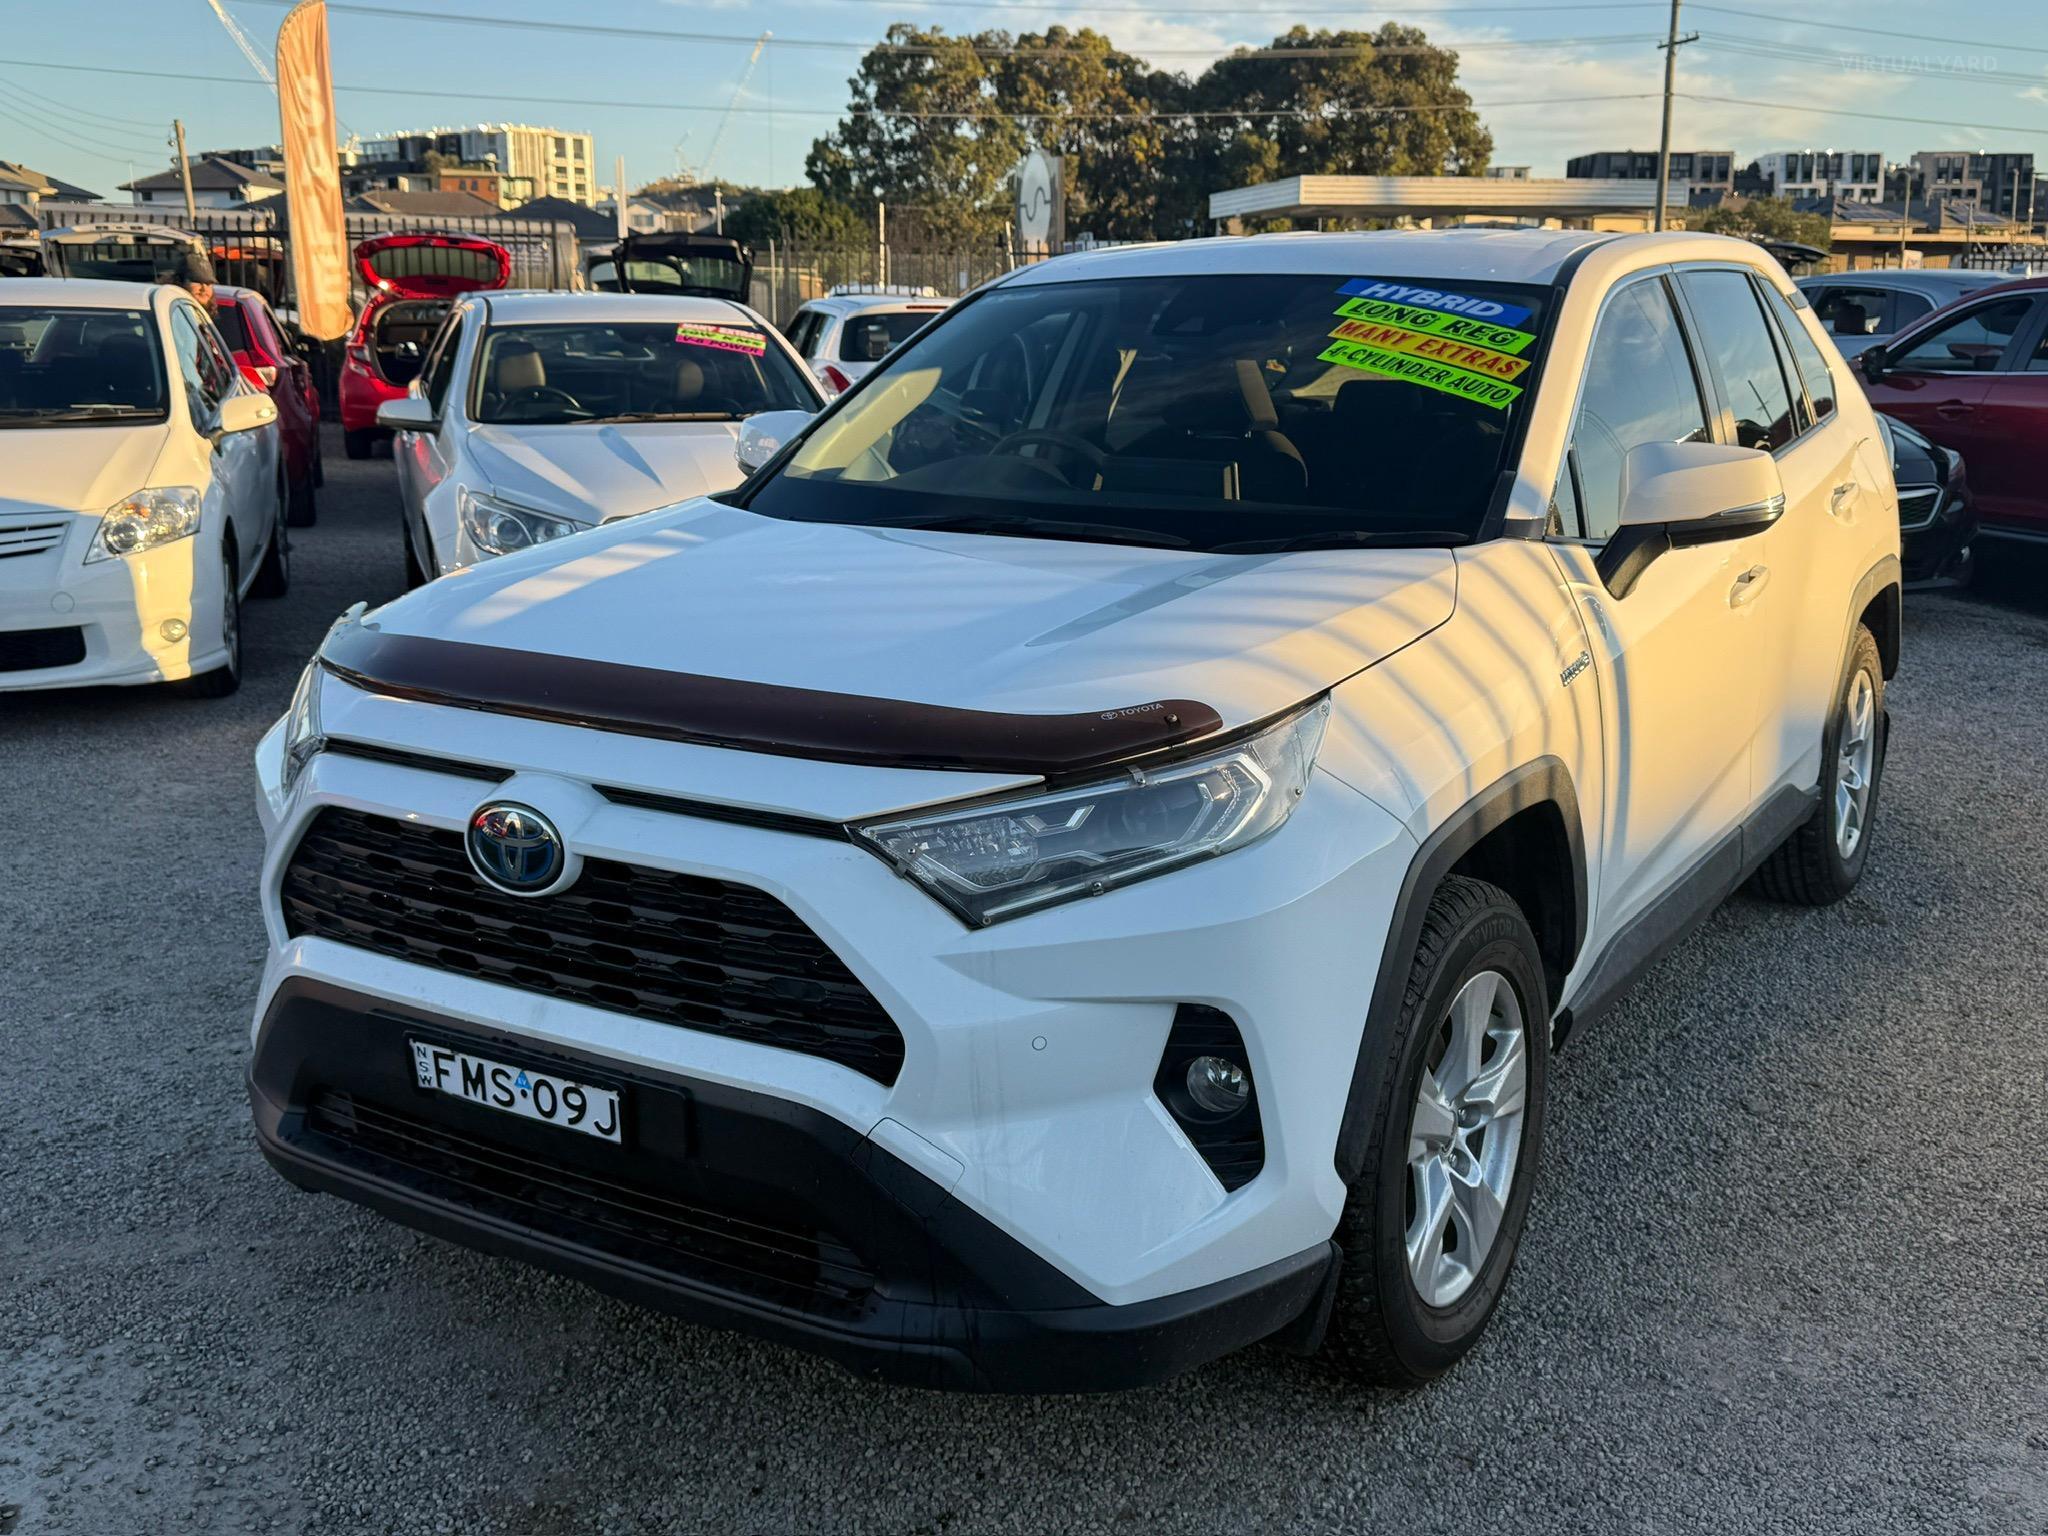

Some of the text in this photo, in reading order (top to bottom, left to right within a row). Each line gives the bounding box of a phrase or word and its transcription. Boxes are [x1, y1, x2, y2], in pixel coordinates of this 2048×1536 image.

[1359, 283, 1504, 317] HYBRID
[1348, 301, 1520, 346] LONG REG
[708, 340, 759, 353] POWER
[1335, 321, 1522, 376] MANY EXTRAS
[1328, 345, 1514, 402] 4-CYLINDER AUTO
[1120, 703, 1164, 716] TOYOTA
